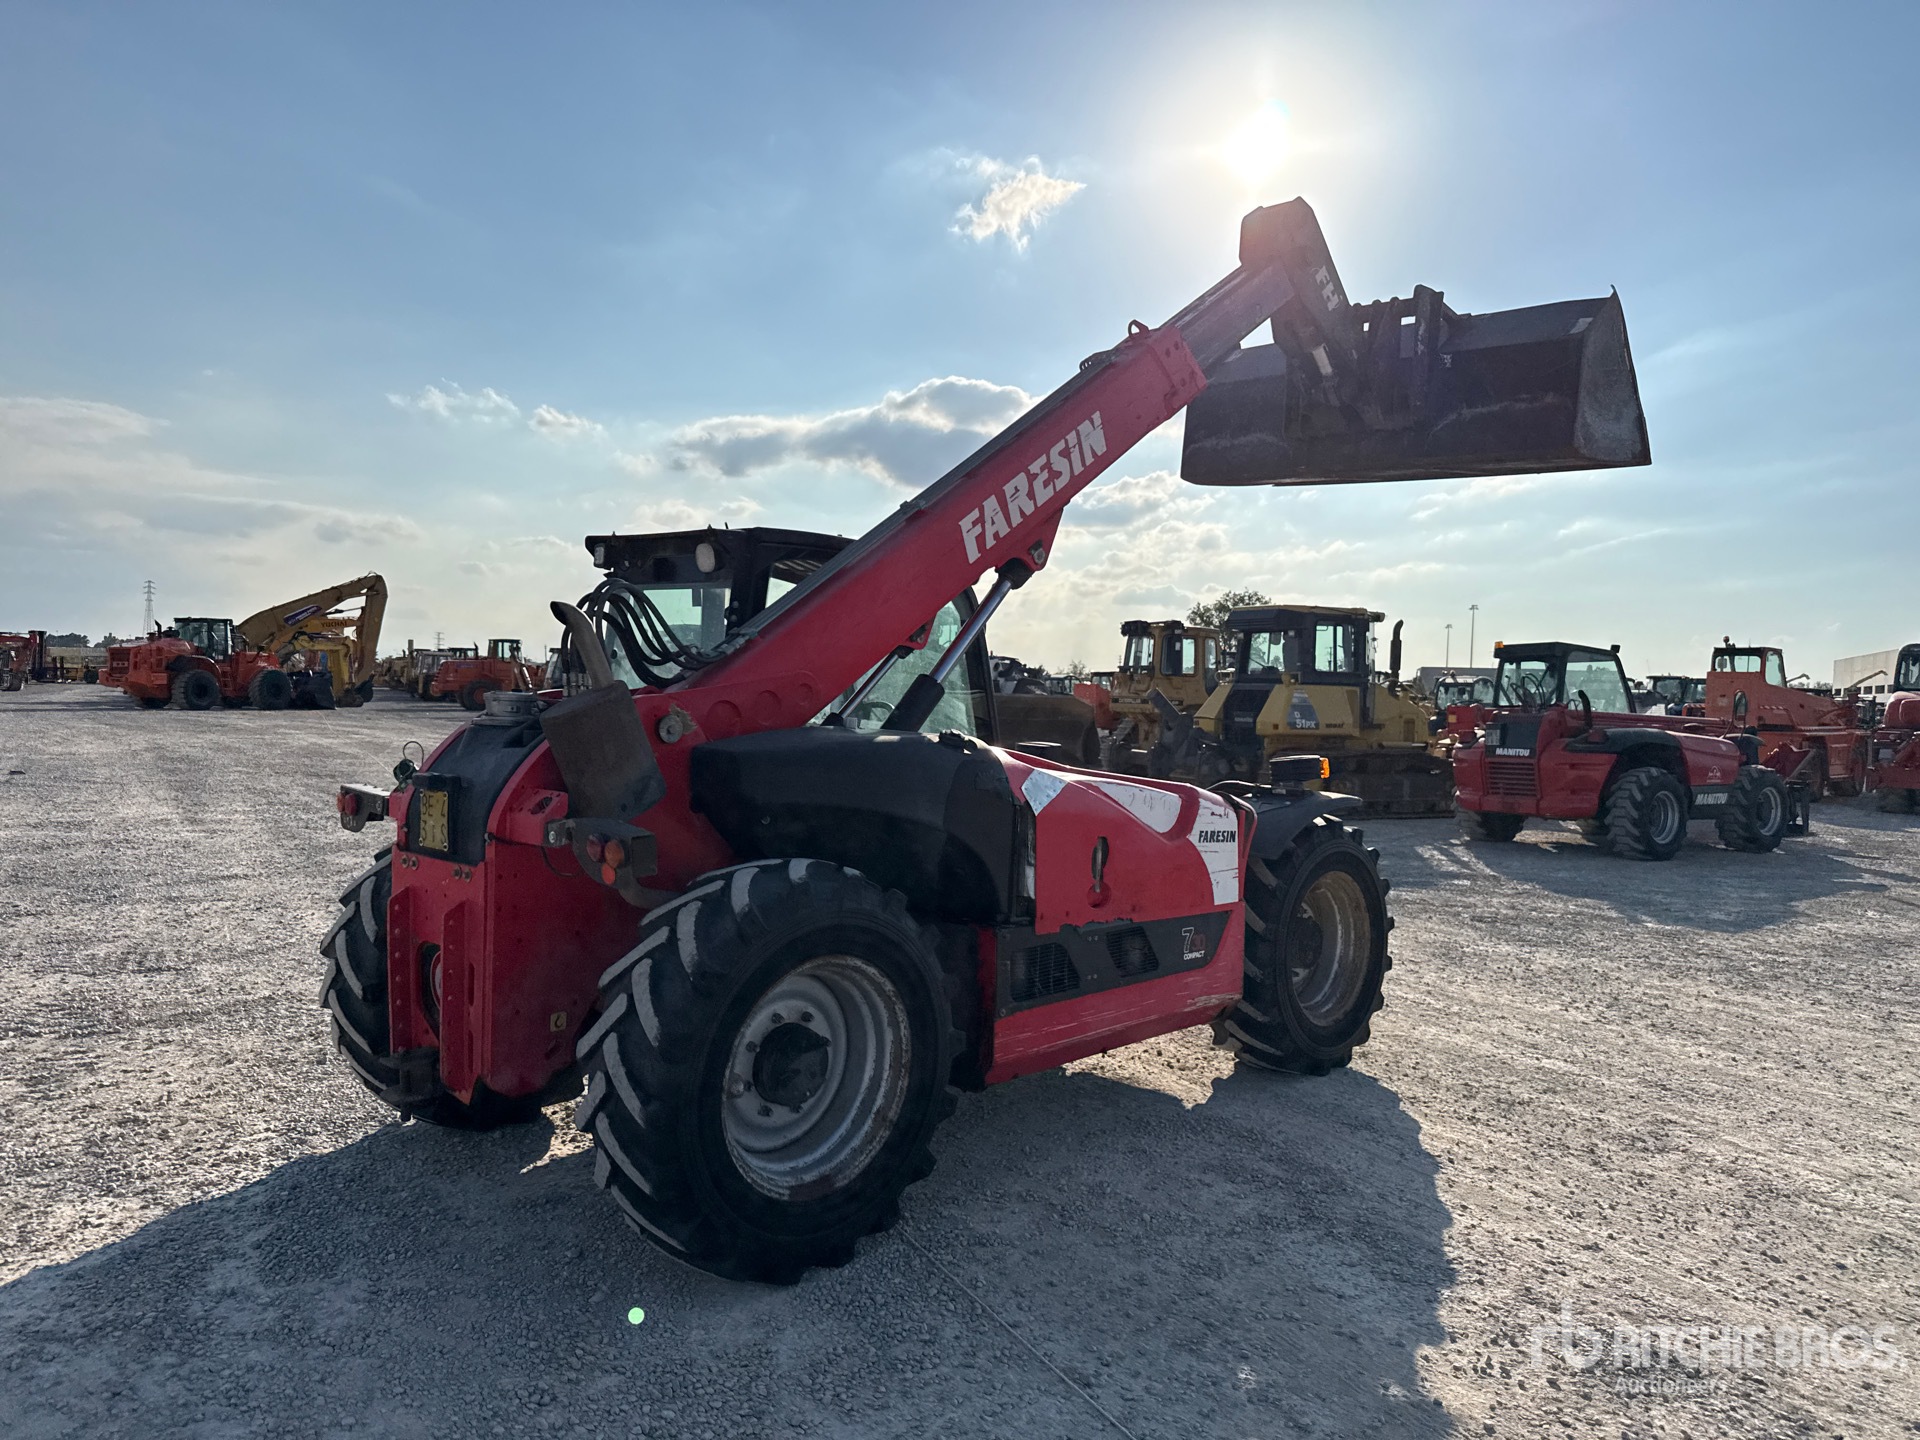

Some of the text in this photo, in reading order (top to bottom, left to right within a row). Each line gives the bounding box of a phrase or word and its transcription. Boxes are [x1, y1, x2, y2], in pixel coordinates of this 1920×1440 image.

[958, 410, 1107, 564] FARESIN
[1495, 747, 1530, 757] MANITOU
[1695, 793, 1728, 805] MANITOU
[1198, 830, 1236, 843] FARESIN
[1184, 950, 1205, 960] COMPACT
